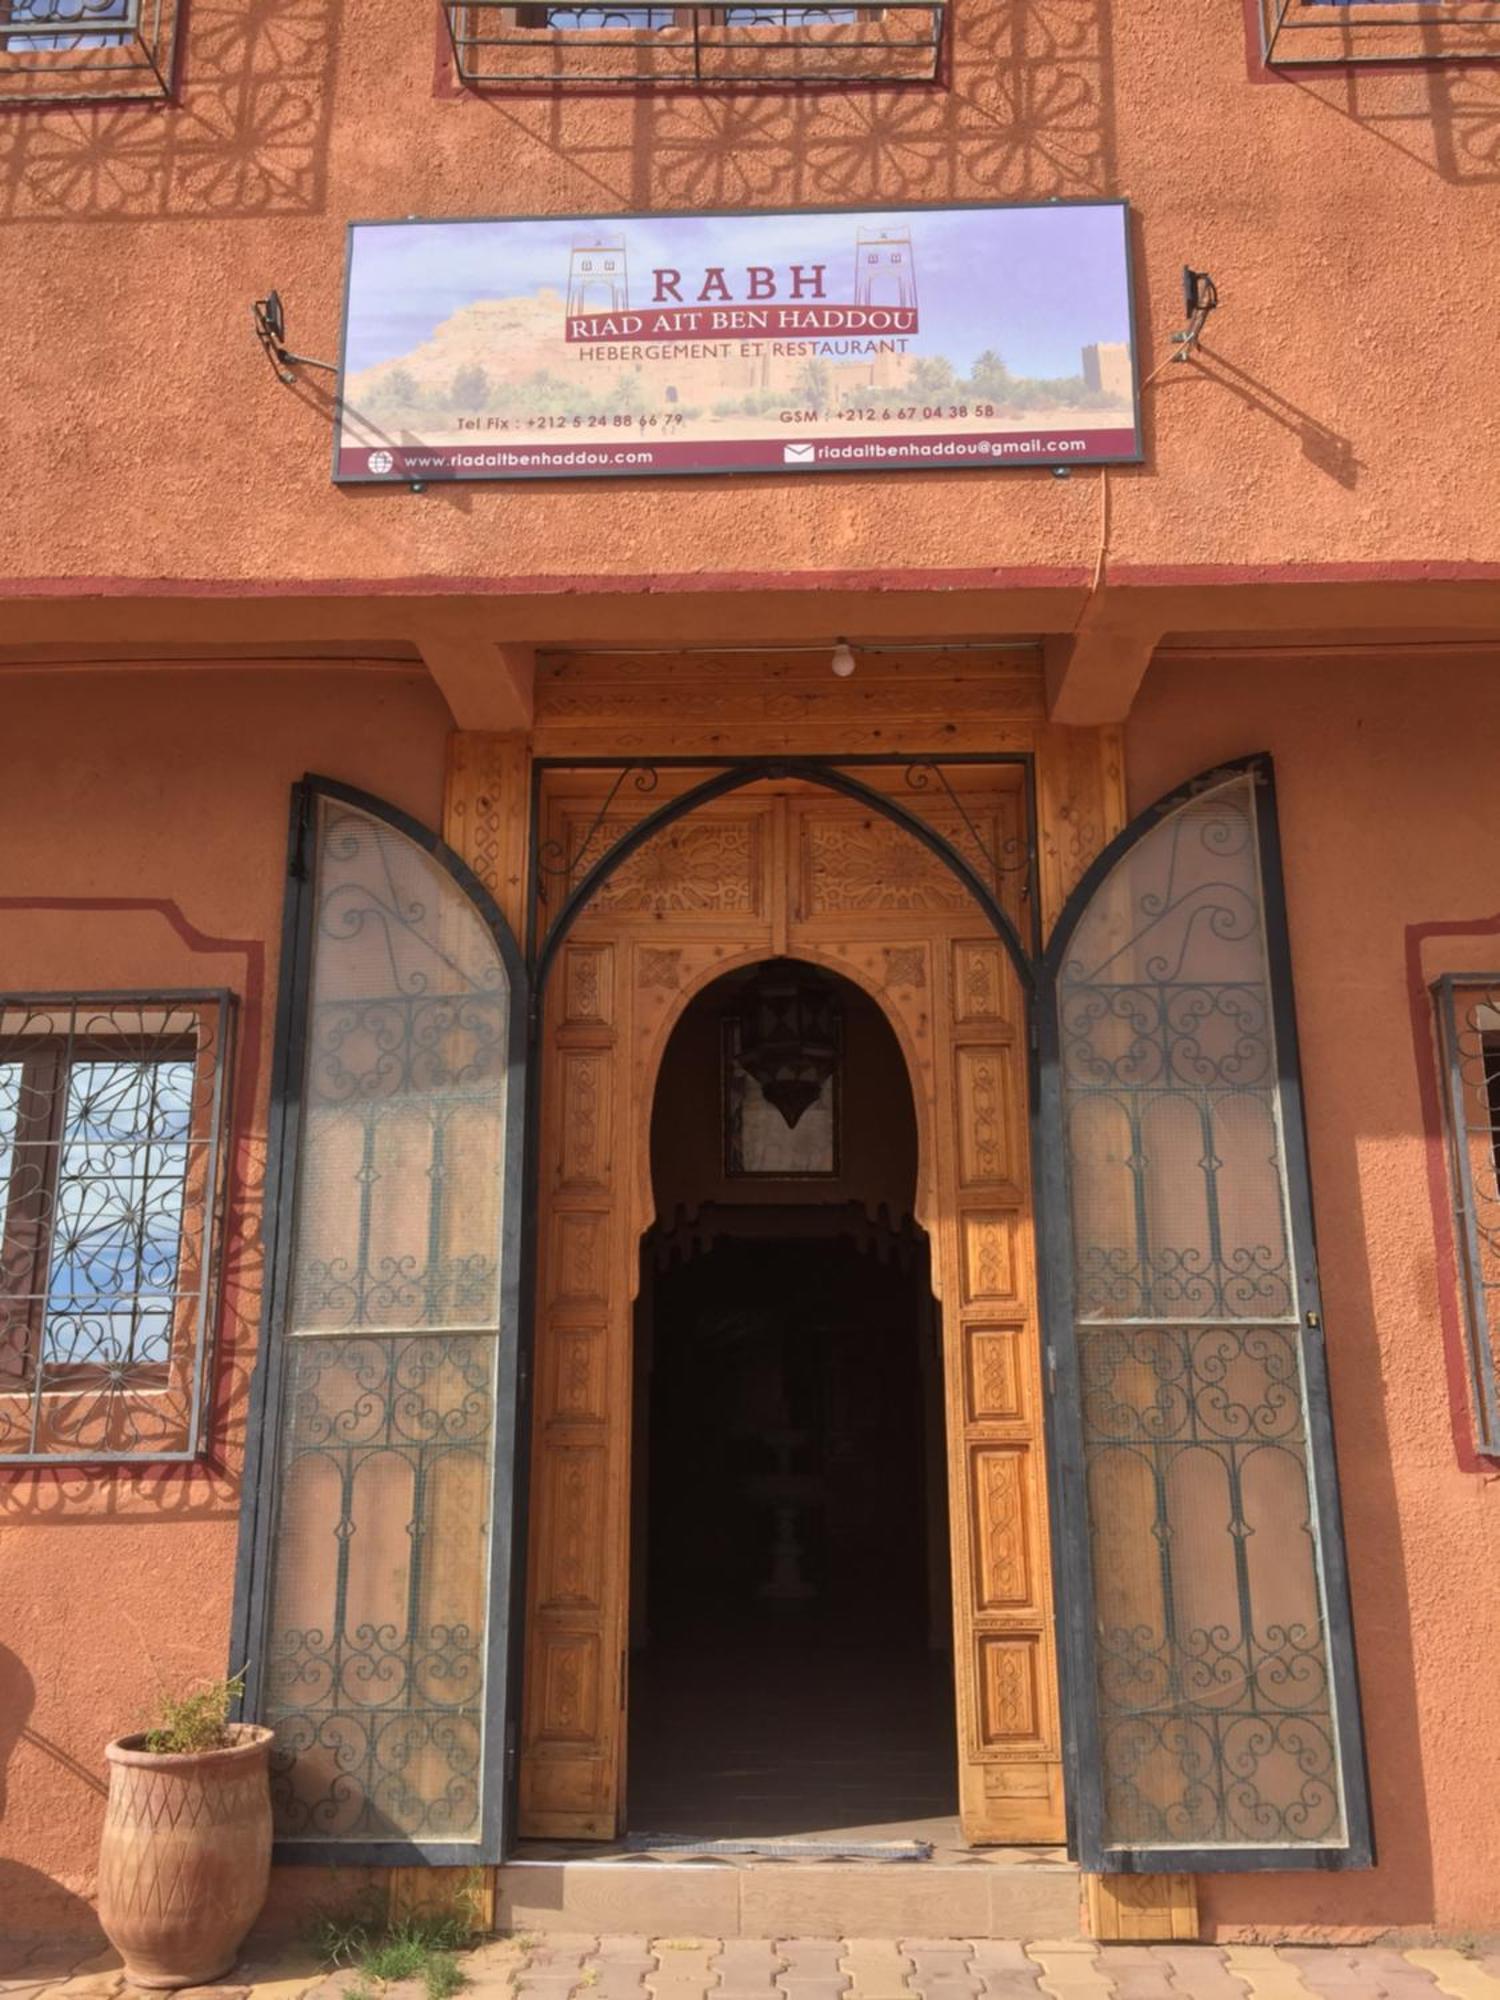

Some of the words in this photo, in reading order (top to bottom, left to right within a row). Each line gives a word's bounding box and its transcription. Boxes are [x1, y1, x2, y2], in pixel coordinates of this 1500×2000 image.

[652, 265, 826, 302] RABH
[571, 316, 643, 339] RIAD
[652, 312, 703, 332] AIT
[711, 310, 768, 330] BEN
[779, 309, 915, 330] HADDOU
[578, 343, 732, 361] HEBERGEMENT
[740, 342, 764, 358] ET
[774, 338, 909, 357] RESTAURANT
[458, 417, 480, 430] Tel
[487, 416, 508, 430] Fix
[528, 416, 566, 429] +212
[572, 416, 581, 428] 5
[588, 415, 607, 427] 24
[613, 414, 632, 427] 88
[639, 414, 657, 427] 66
[665, 413, 683, 425] 79
[779, 410, 817, 423] GSM
[836, 408, 875, 421] +212
[882, 408, 890, 420] 6
[897, 407, 916, 420] 67
[923, 406, 942, 419] 04
[950, 405, 968, 418] 38
[975, 404, 994, 417] 58
[404, 451, 653, 468] www.riadaitbenhaddou.com
[818, 438, 1086, 460] riadaitbenhaddou@gmail.com
